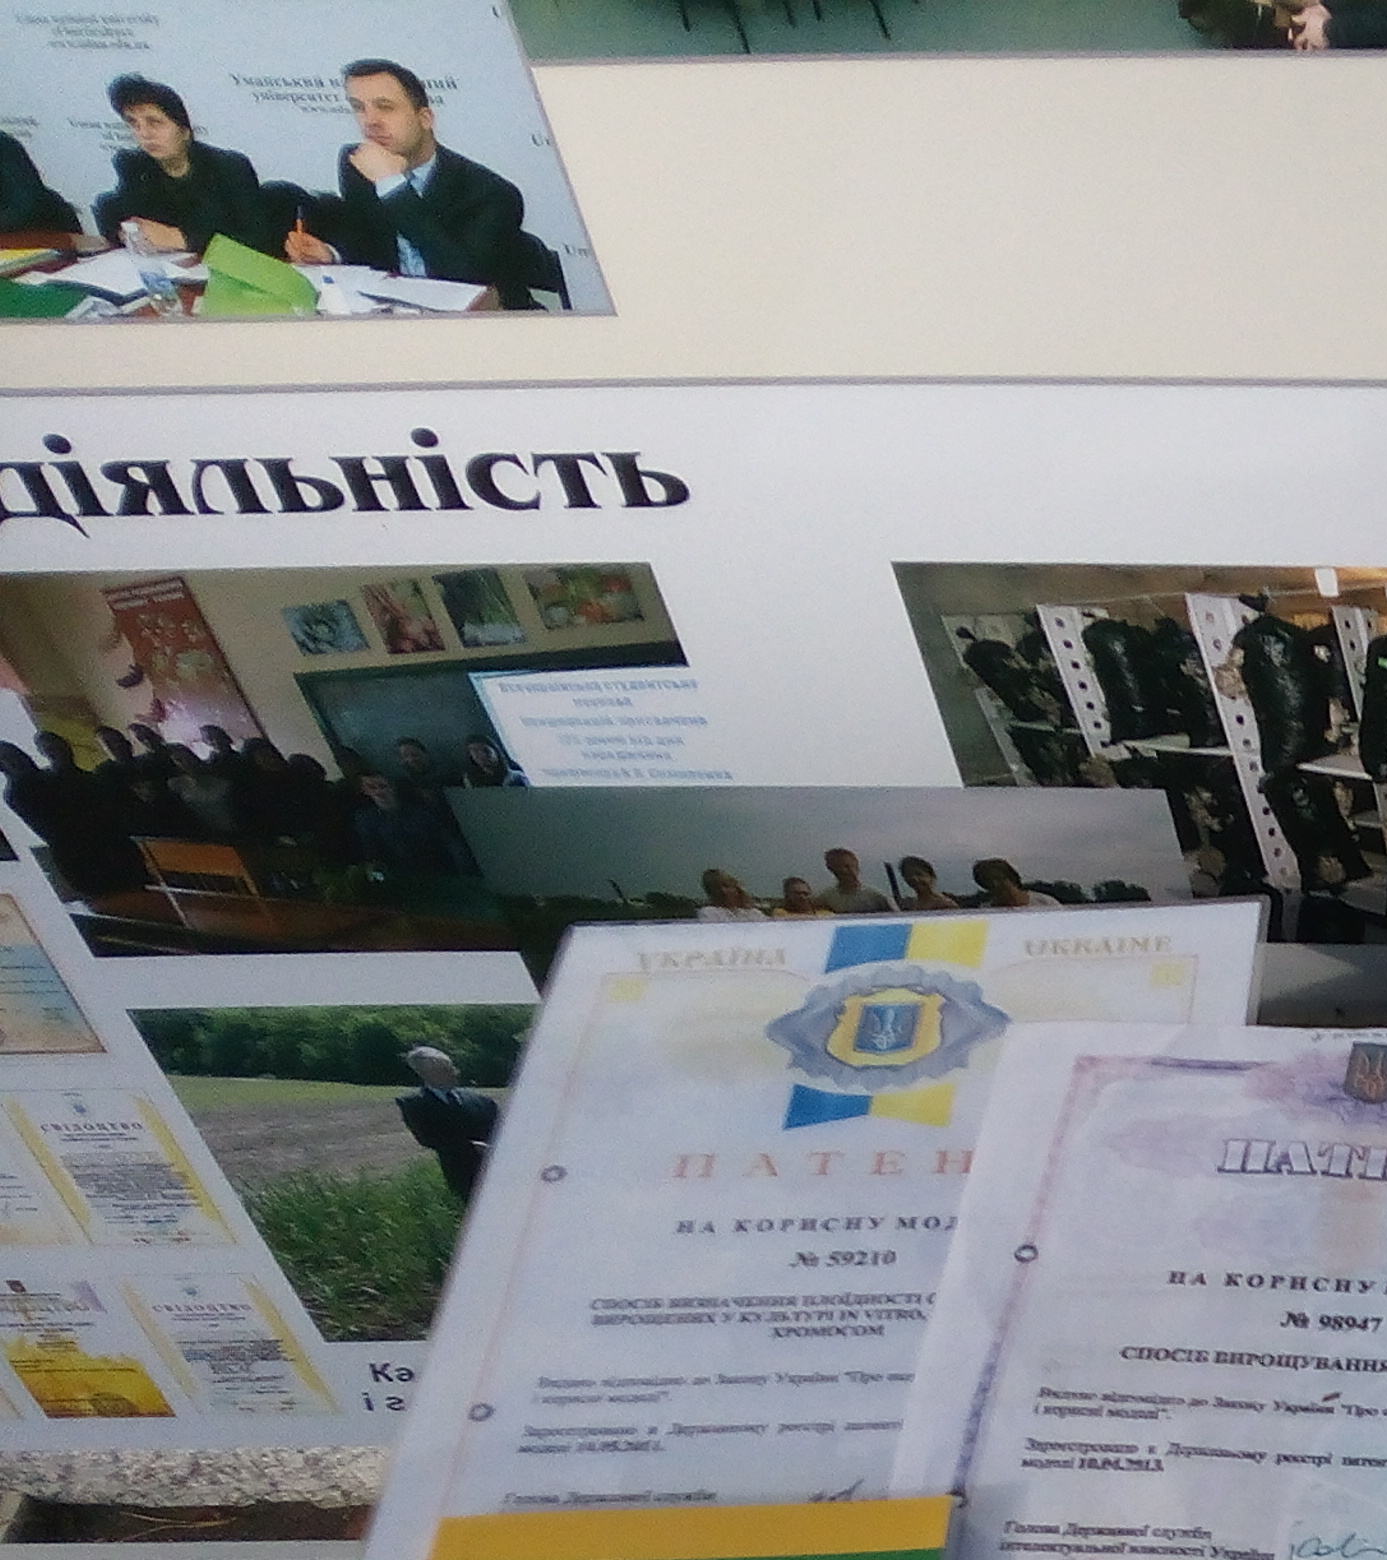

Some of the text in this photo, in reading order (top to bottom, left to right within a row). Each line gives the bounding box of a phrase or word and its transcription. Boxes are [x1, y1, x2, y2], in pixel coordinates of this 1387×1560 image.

[0, 427, 690, 538] діяльність
[1024, 935, 1173, 956] UKRAINE
[639, 946, 786, 971] УКРАЇНА
[676, 1217, 886, 1235] НА КОРИСНУ
[1168, 1270, 1208, 1287] НА
[1223, 1272, 1376, 1295] КОРИСНУ
[1318, 1313, 1383, 1333] 98947
